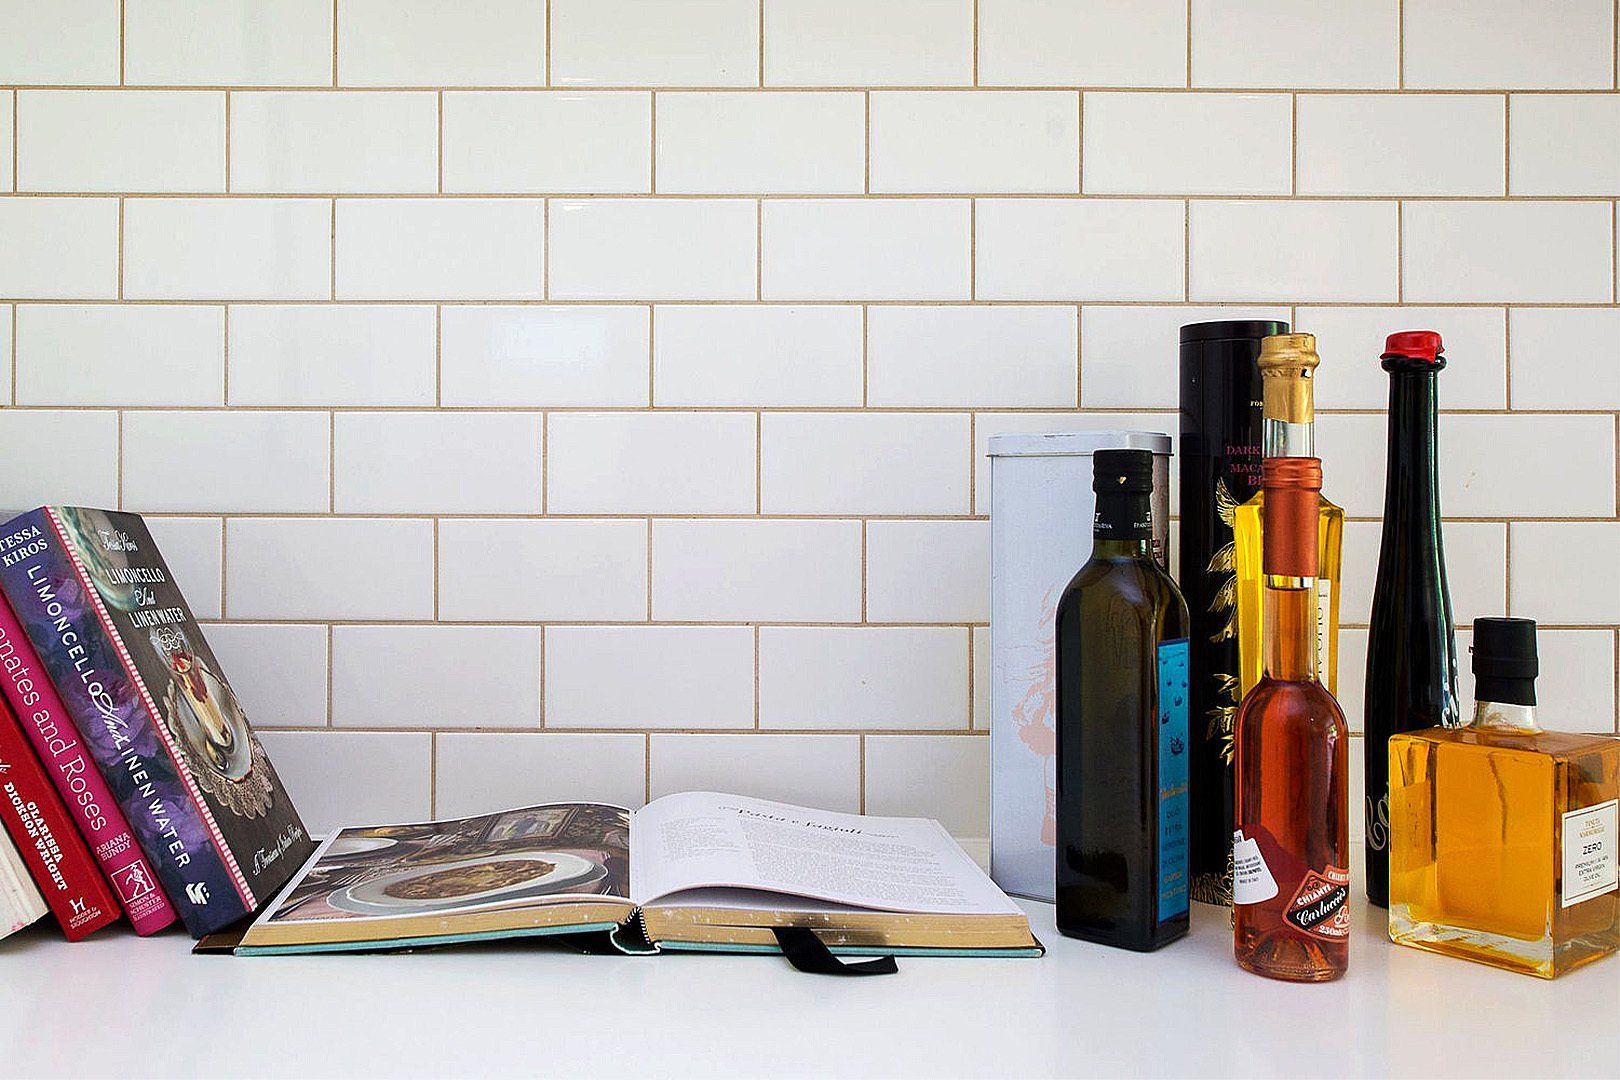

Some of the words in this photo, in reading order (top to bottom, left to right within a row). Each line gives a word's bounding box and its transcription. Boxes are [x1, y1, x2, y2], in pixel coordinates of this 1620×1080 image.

[1226, 446, 1261, 456] DARK
[2, 539, 48, 568] KIROS
[106, 567, 165, 585] LIMONCELLO
[128, 610, 158, 629] LINEN
[156, 607, 187, 626] WATER
[28, 565, 103, 697] LIMONCELLO
[115, 736, 156, 798] LINEN
[148, 800, 191, 869] WATER
[33, 709, 77, 757] and
[59, 754, 107, 832] Roses
[4, 781, 39, 838] DICKSON
[35, 837, 68, 891] WRIGHT
[27, 801, 64, 863] CLARISSA
[96, 832, 130, 855] ARIANA
[101, 840, 131, 861] BUNDY
[1582, 841, 1602, 855] ZERO
